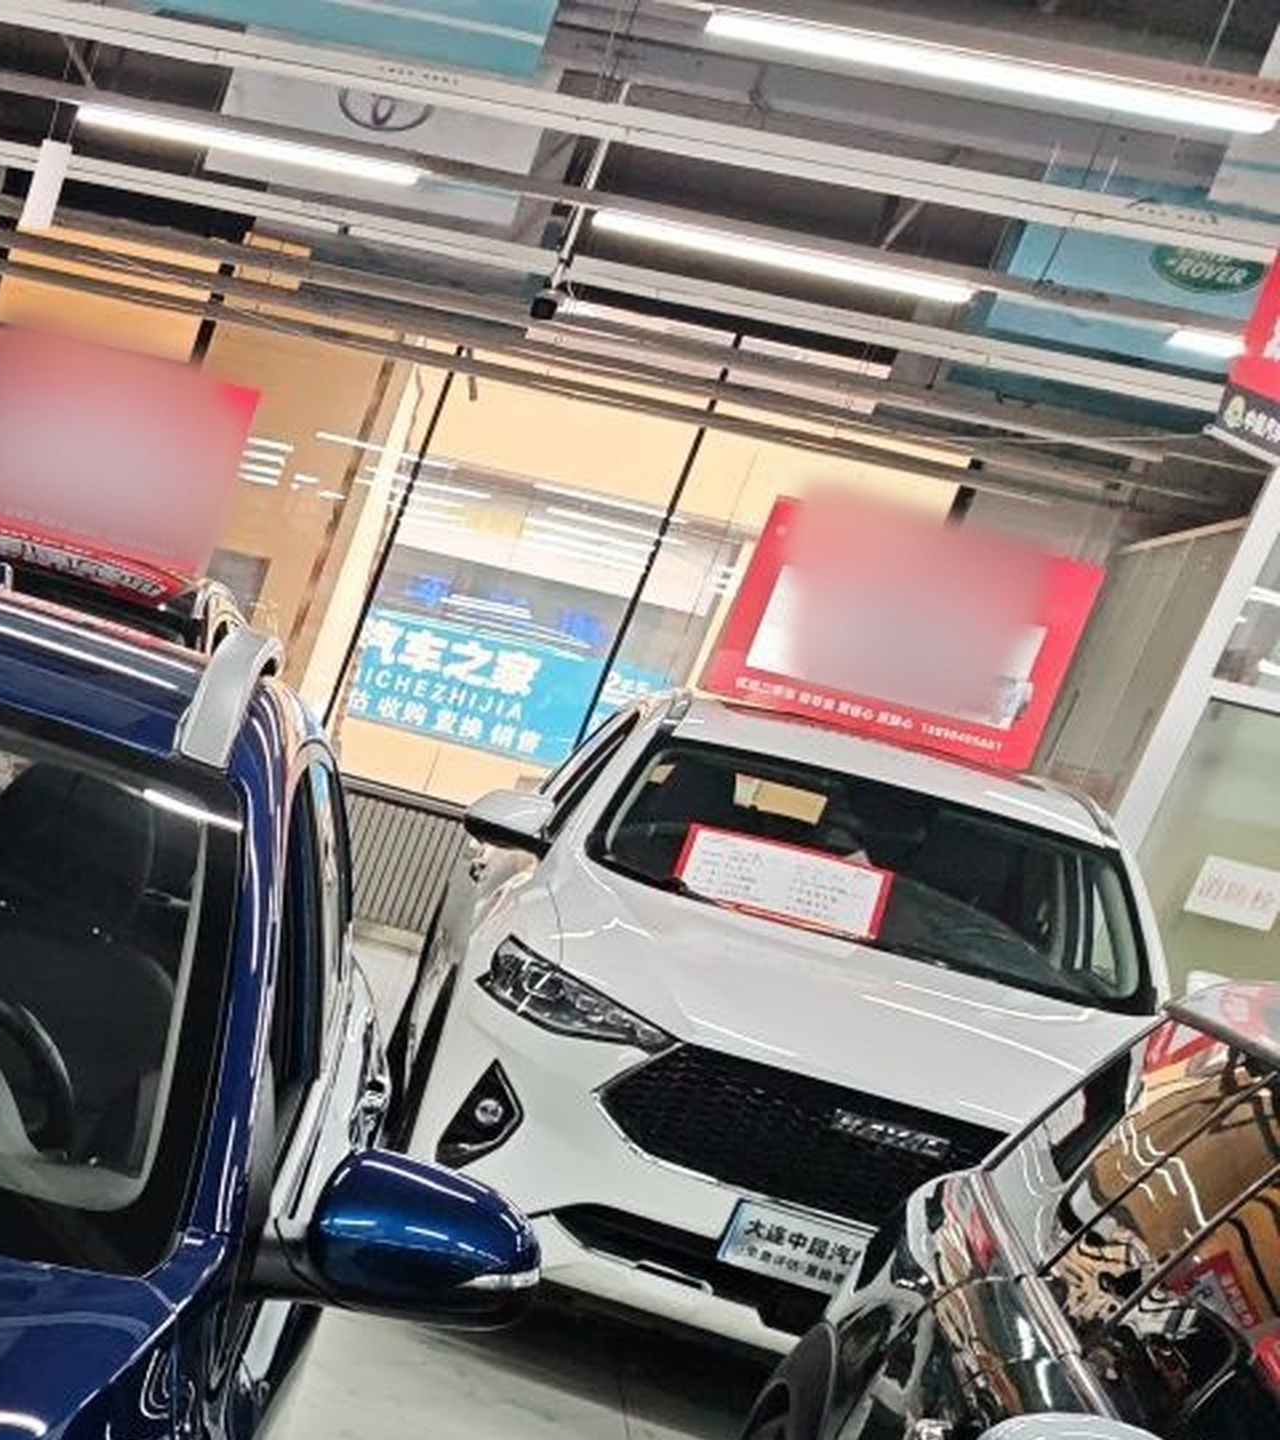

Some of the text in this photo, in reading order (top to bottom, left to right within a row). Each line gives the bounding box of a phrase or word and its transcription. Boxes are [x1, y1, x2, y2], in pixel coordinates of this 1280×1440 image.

[1175, 258, 1249, 285] ROVER
[359, 616, 542, 696] 汽车之家
[354, 667, 523, 721] ICHEZHIJIA
